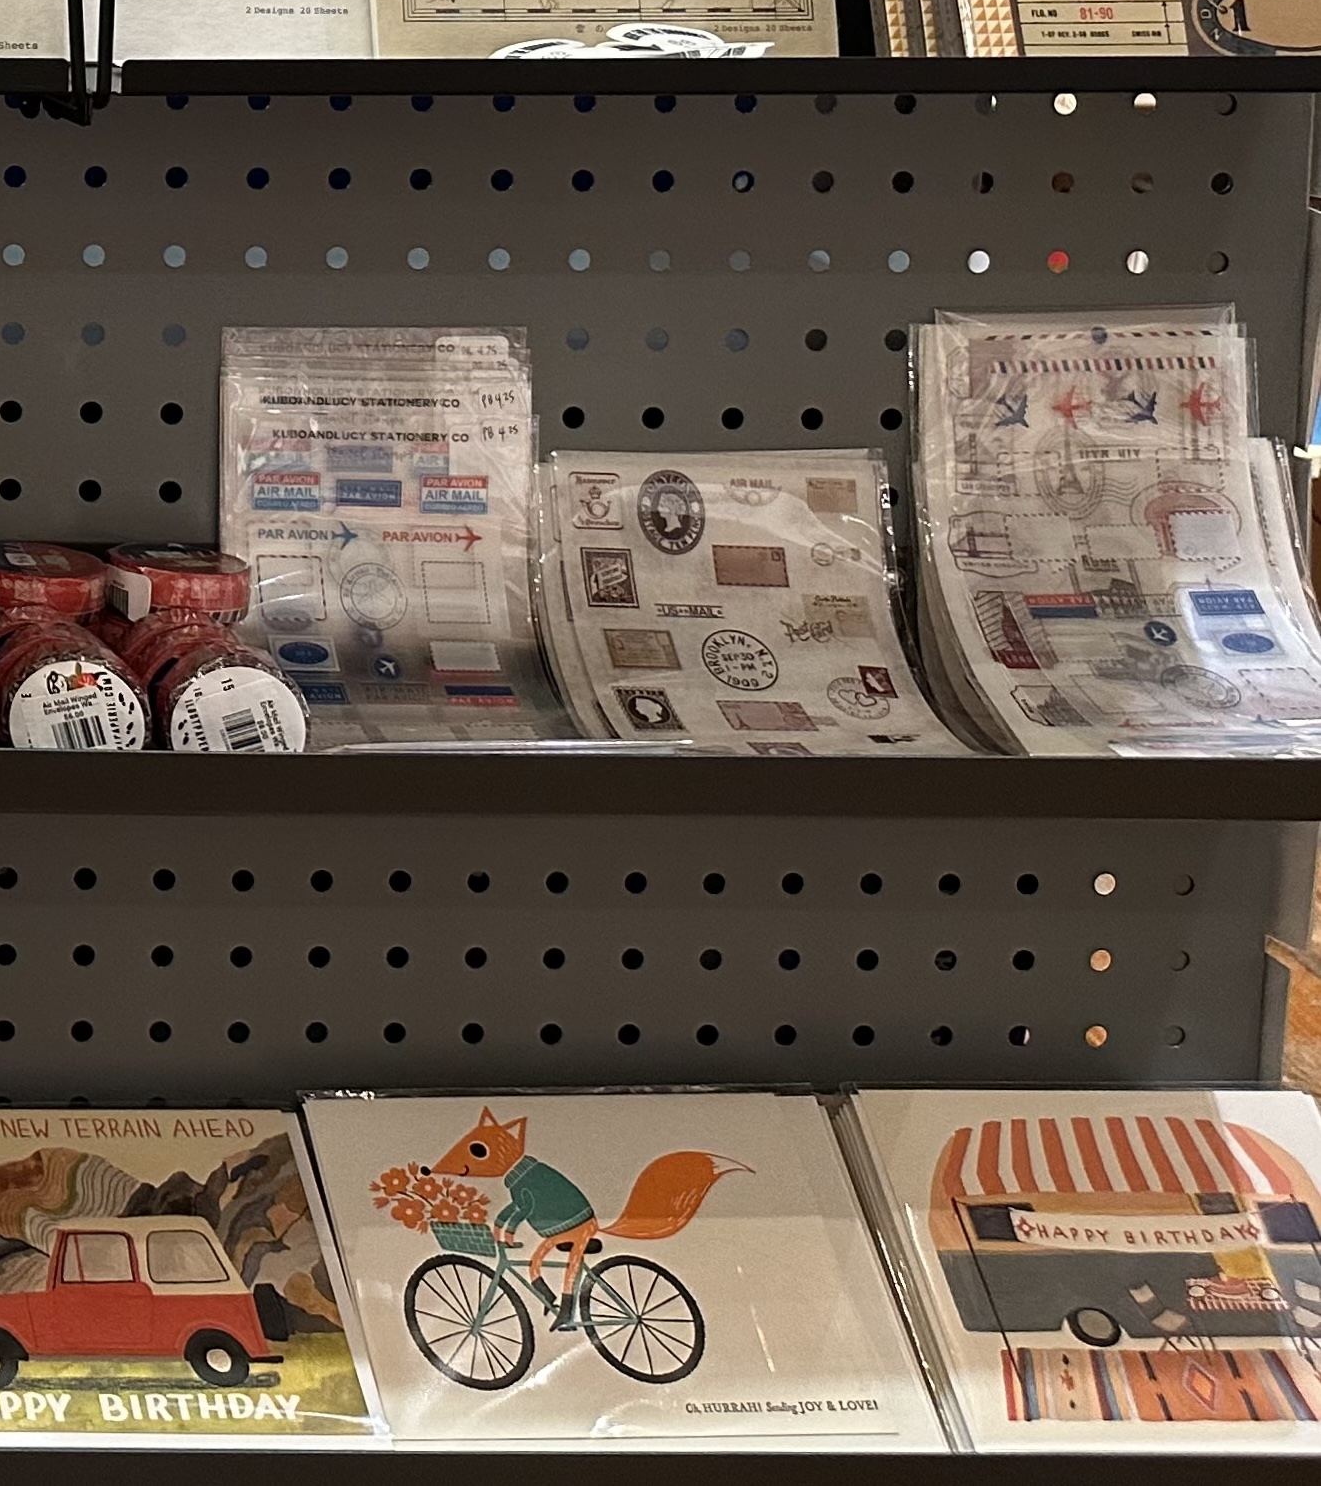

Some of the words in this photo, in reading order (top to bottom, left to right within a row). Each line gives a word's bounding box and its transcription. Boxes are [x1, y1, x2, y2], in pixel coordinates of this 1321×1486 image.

[424, 489, 445, 501] AIR
[447, 489, 484, 501] MAIL
[257, 528, 286, 540] PAR
[287, 528, 329, 541] AVION
[382, 530, 408, 542] PAR
[411, 530, 453, 543] AVION
[1, 1116, 50, 1139] NEW
[57, 1116, 164, 1140] TERRAIN
[172, 1116, 256, 1139] AHEAD
[1036, 1223, 1110, 1242] HAPPY
[1124, 1224, 1247, 1246] BIRTHDAY
[98, 1390, 302, 1424] BIRTHDAY
